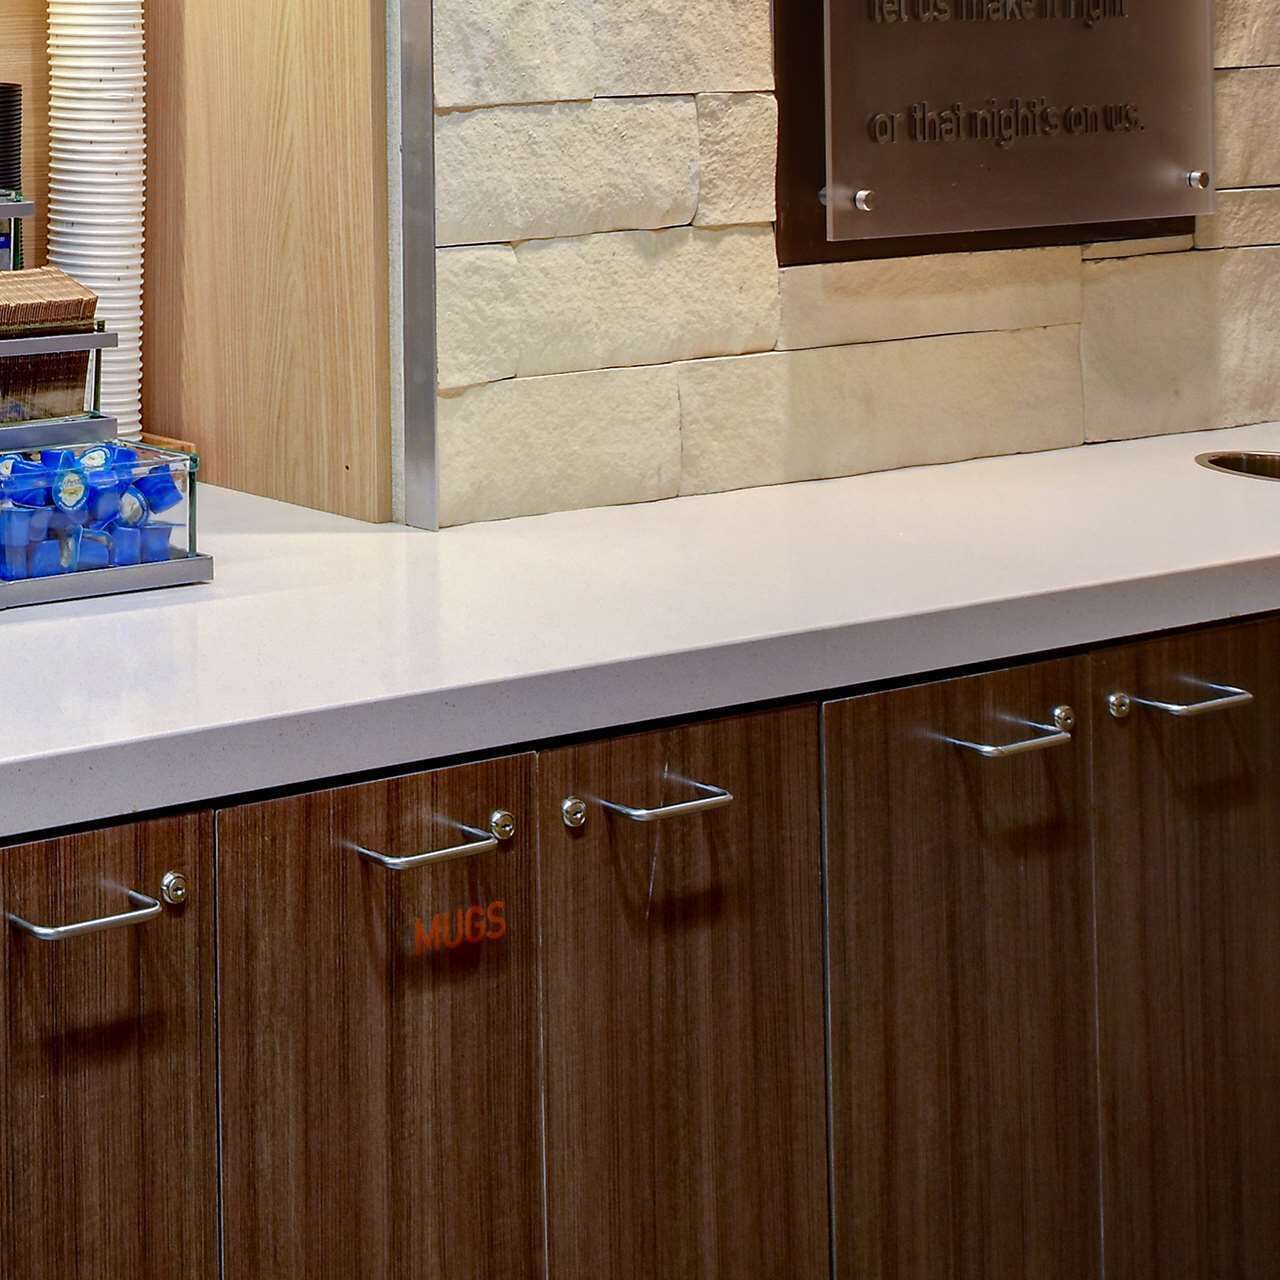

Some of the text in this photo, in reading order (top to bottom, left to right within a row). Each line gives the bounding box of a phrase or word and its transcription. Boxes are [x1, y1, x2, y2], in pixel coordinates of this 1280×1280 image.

[868, 96, 1145, 150] or that night's on us.
[414, 899, 507, 956] MUGS
